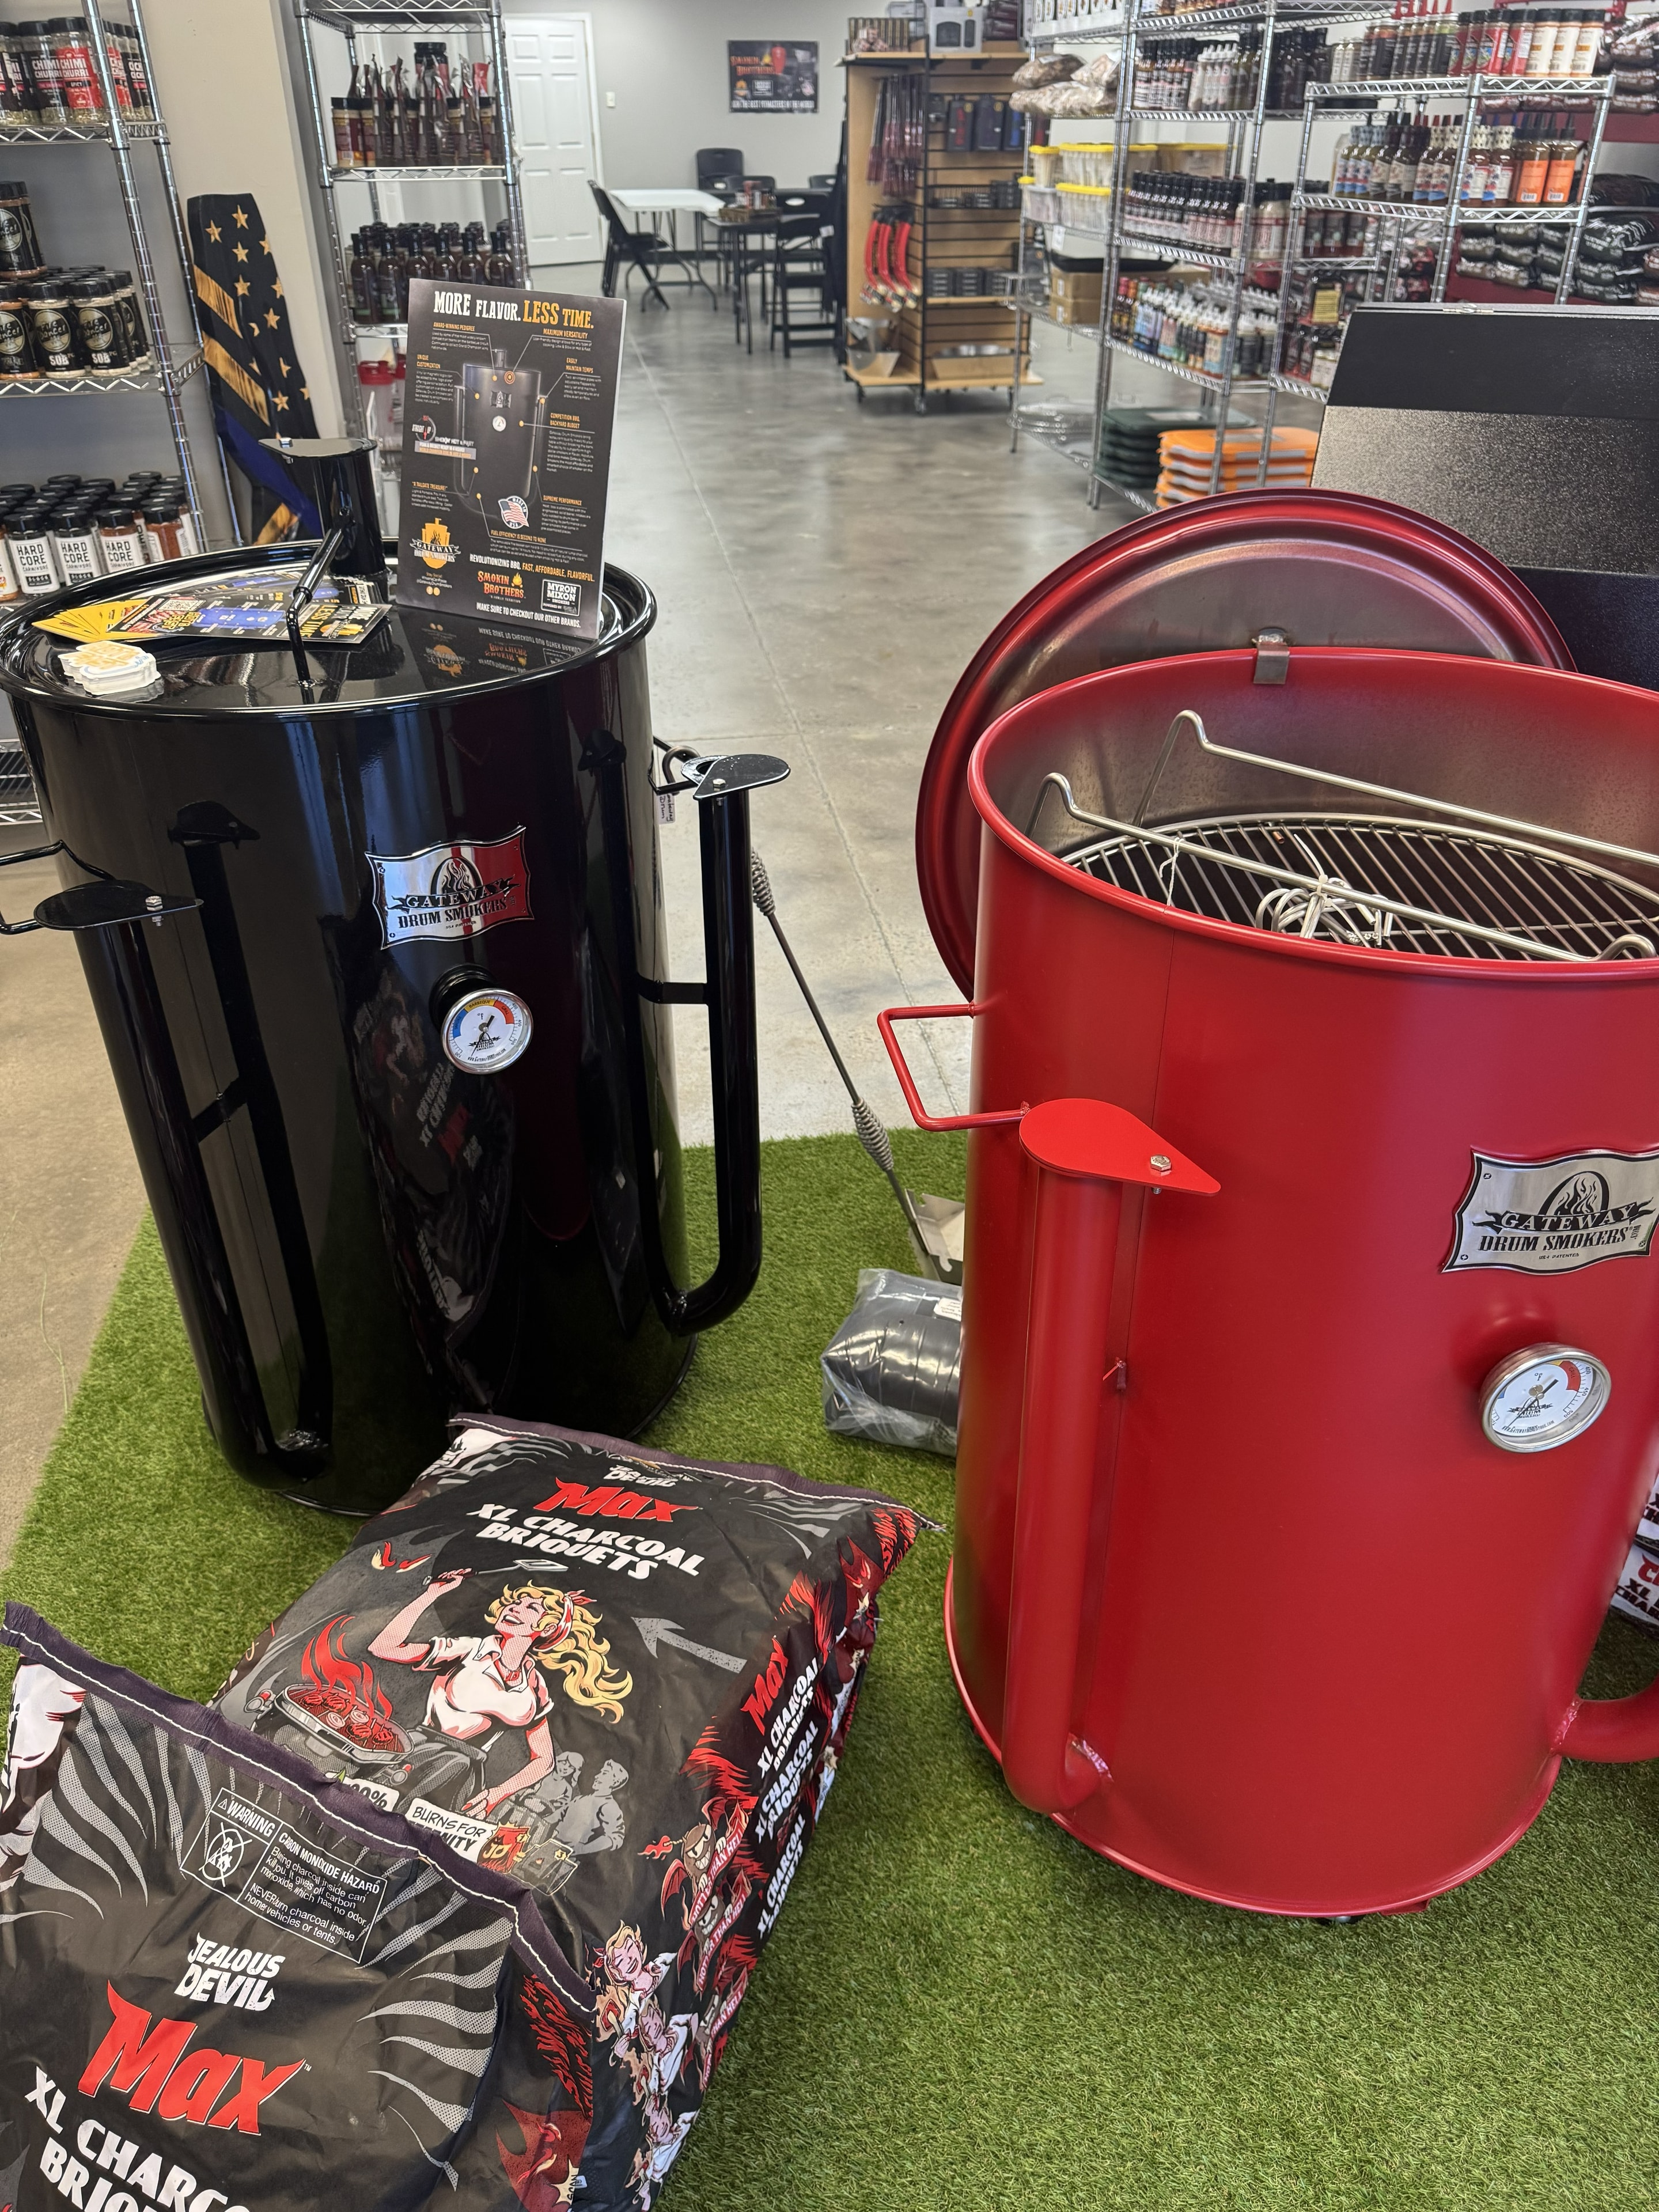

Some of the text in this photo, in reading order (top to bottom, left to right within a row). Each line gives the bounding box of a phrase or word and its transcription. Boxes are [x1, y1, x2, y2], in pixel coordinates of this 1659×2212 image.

[32, 58, 59, 70] CHIMI
[35, 69, 62, 78] CHURRI
[60, 58, 86, 70] CHIMI
[63, 69, 89, 77] CHURRI
[433, 291, 594, 329] MORE FLAVOR. LESS TIME.
[543, 328, 588, 339] MAXIMUM VERSATILITY
[512, 498, 523, 508] MADE
[558, 497, 582, 506] PERFORMANCE
[16, 544, 44, 556] HARD
[20, 554, 46, 566] CORE
[60, 542, 88, 554] HARD
[63, 552, 90, 563] CORE
[105, 541, 131, 552] HARD
[108, 551, 133, 562] CORE
[416, 541, 453, 553] GATEWAY
[469, 554, 595, 582] REVOLUTIONIZING BBQ. FAST, AFFORDABLE, FLAVORFUL.
[478, 571, 509, 585] SMOKIN
[484, 582, 524, 599] BROTHERS
[547, 582, 577, 594] MYRON
[547, 590, 576, 601] MIXON
[476, 602, 581, 628] MAKE SURE TO CHECKOUT OUR OTHER BRANDS.
[406, 879, 504, 908] GATEWAY
[398, 898, 507, 929] DRUM SMOKERS
[1501, 1203, 1635, 1230] GATEWAY
[1478, 1235, 1539, 1252] DRUM
[1563, 1410, 1574, 1418] 500
[533, 1477, 702, 1522] Max
[465, 1503, 705, 1577] XL CHARCOAL
[476, 1522, 659, 1580] BRIQUETS
[1624, 1578, 1650, 1601] XL
[740, 1638, 789, 1736] Max
[757, 1657, 818, 1779] XL CHARCOAL
[755, 1720, 819, 1844] XL CHARCOAL
[228, 1800, 276, 1838] WARNING
[414, 1806, 487, 1838] BURNS FOR
[440, 1832, 478, 1851] NITY
[710, 1850, 728, 1879] THAN
[726, 1829, 743, 1857] HELL
[292, 1862, 366, 1904] charcoal inside can
[299, 1846, 341, 1880] MONOXIDE
[340, 1870, 381, 1895] HAZARD
[757, 1813, 805, 1940] XL CHARCOAL
[294, 1883, 315, 1904] which
[317, 1894, 334, 1911] has
[334, 1905, 346, 1916] no
[347, 1909, 368, 1928] odor.
[295, 1874, 313, 1892] gives
[313, 1884, 324, 1896] off
[325, 1889, 357, 1910] carbon
[249, 1883, 277, 1907] NEVER
[289, 1907, 329, 1929] charcoal
[330, 1922, 355, 1942] inside
[265, 1904, 336, 1945] vehicles or tents.
[713, 1894, 746, 1945] THAN HELL
[187, 1933, 285, 1978] JEALOUS
[174, 1964, 276, 2011] DEVIL
[726, 1990, 743, 2017] HELL
[78, 1980, 306, 2136] Max
[24, 2066, 66, 2134] XL
